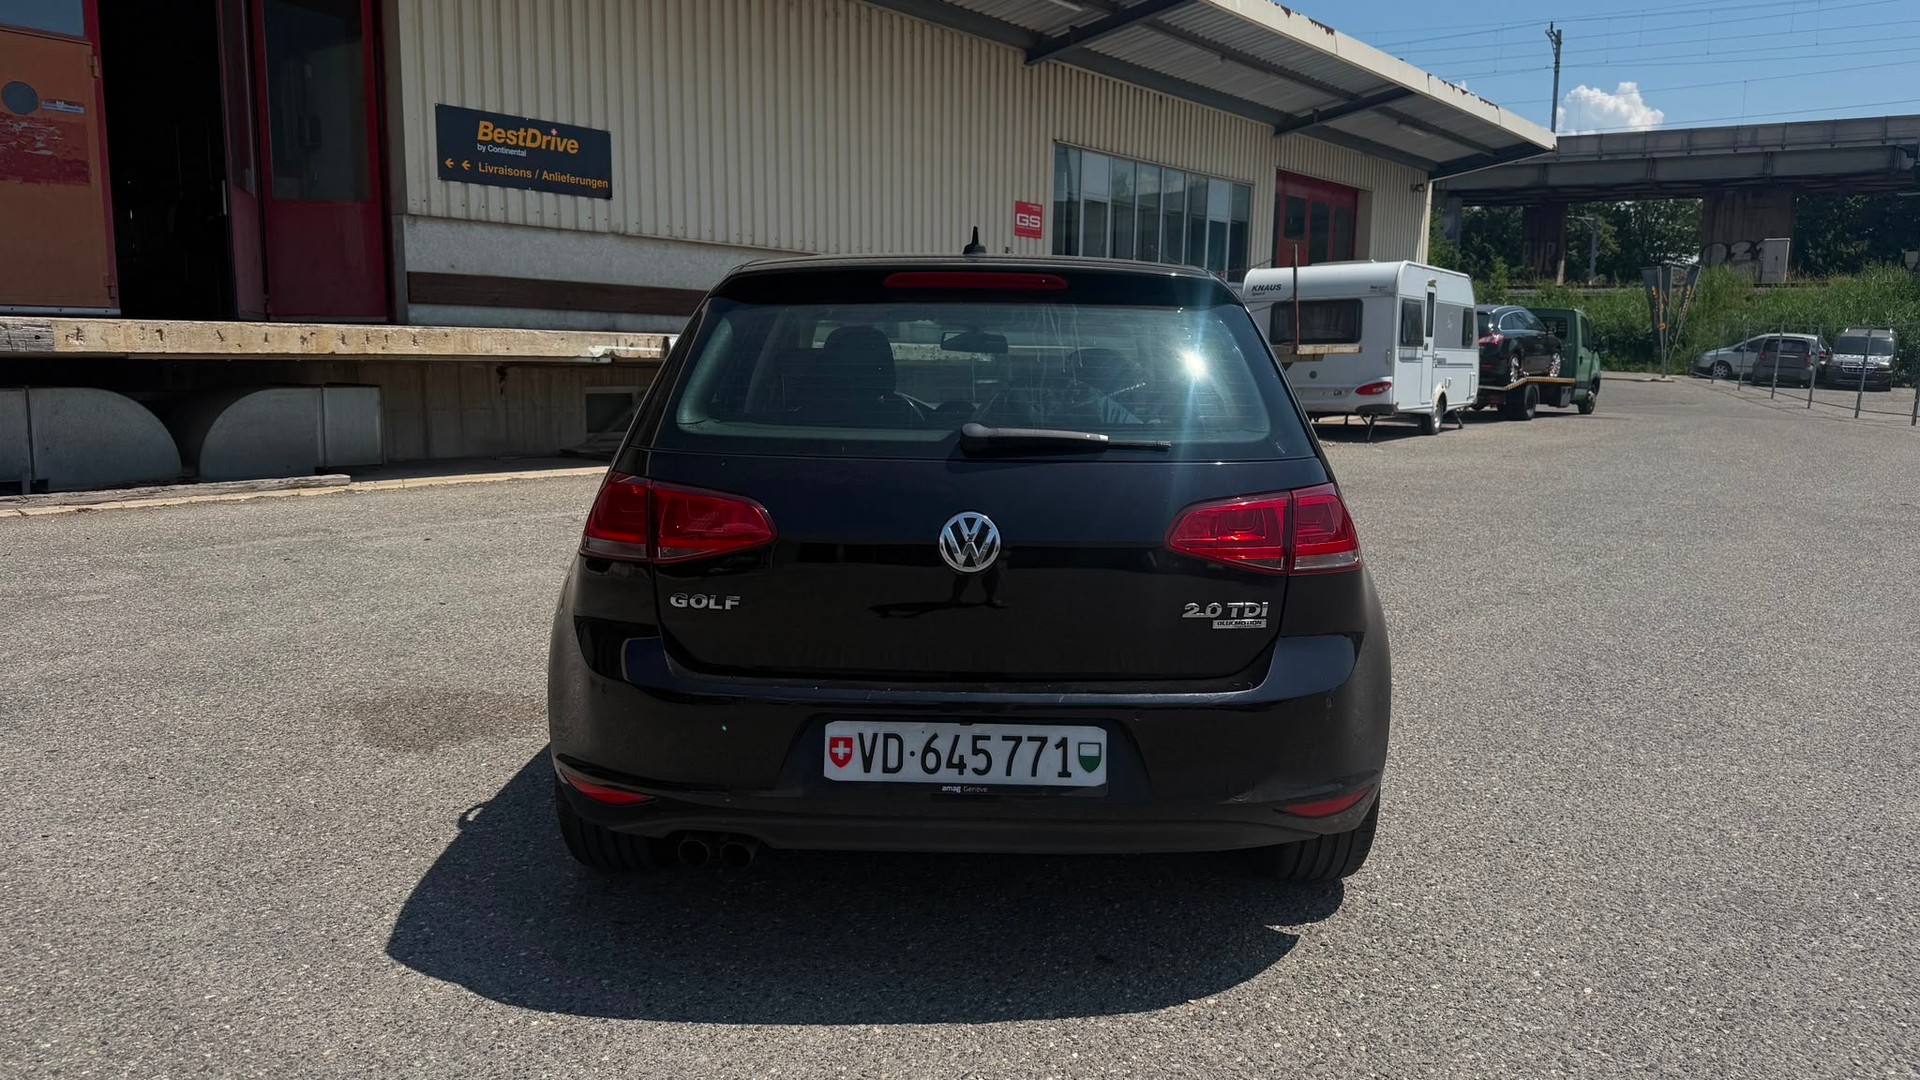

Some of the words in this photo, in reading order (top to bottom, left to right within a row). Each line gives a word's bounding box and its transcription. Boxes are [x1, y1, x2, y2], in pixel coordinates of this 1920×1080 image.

[477, 120, 580, 155] BestDrive
[477, 143, 487, 153] by
[487, 144, 527, 157] Continental
[478, 161, 533, 179] Livraisons
[542, 170, 609, 189] Anlieferungen
[1016, 213, 1041, 228] GS
[1251, 283, 1282, 292] KNAUS
[669, 592, 741, 610] GOLF
[1182, 602, 1223, 618] 2.0
[941, 785, 961, 794] amag
